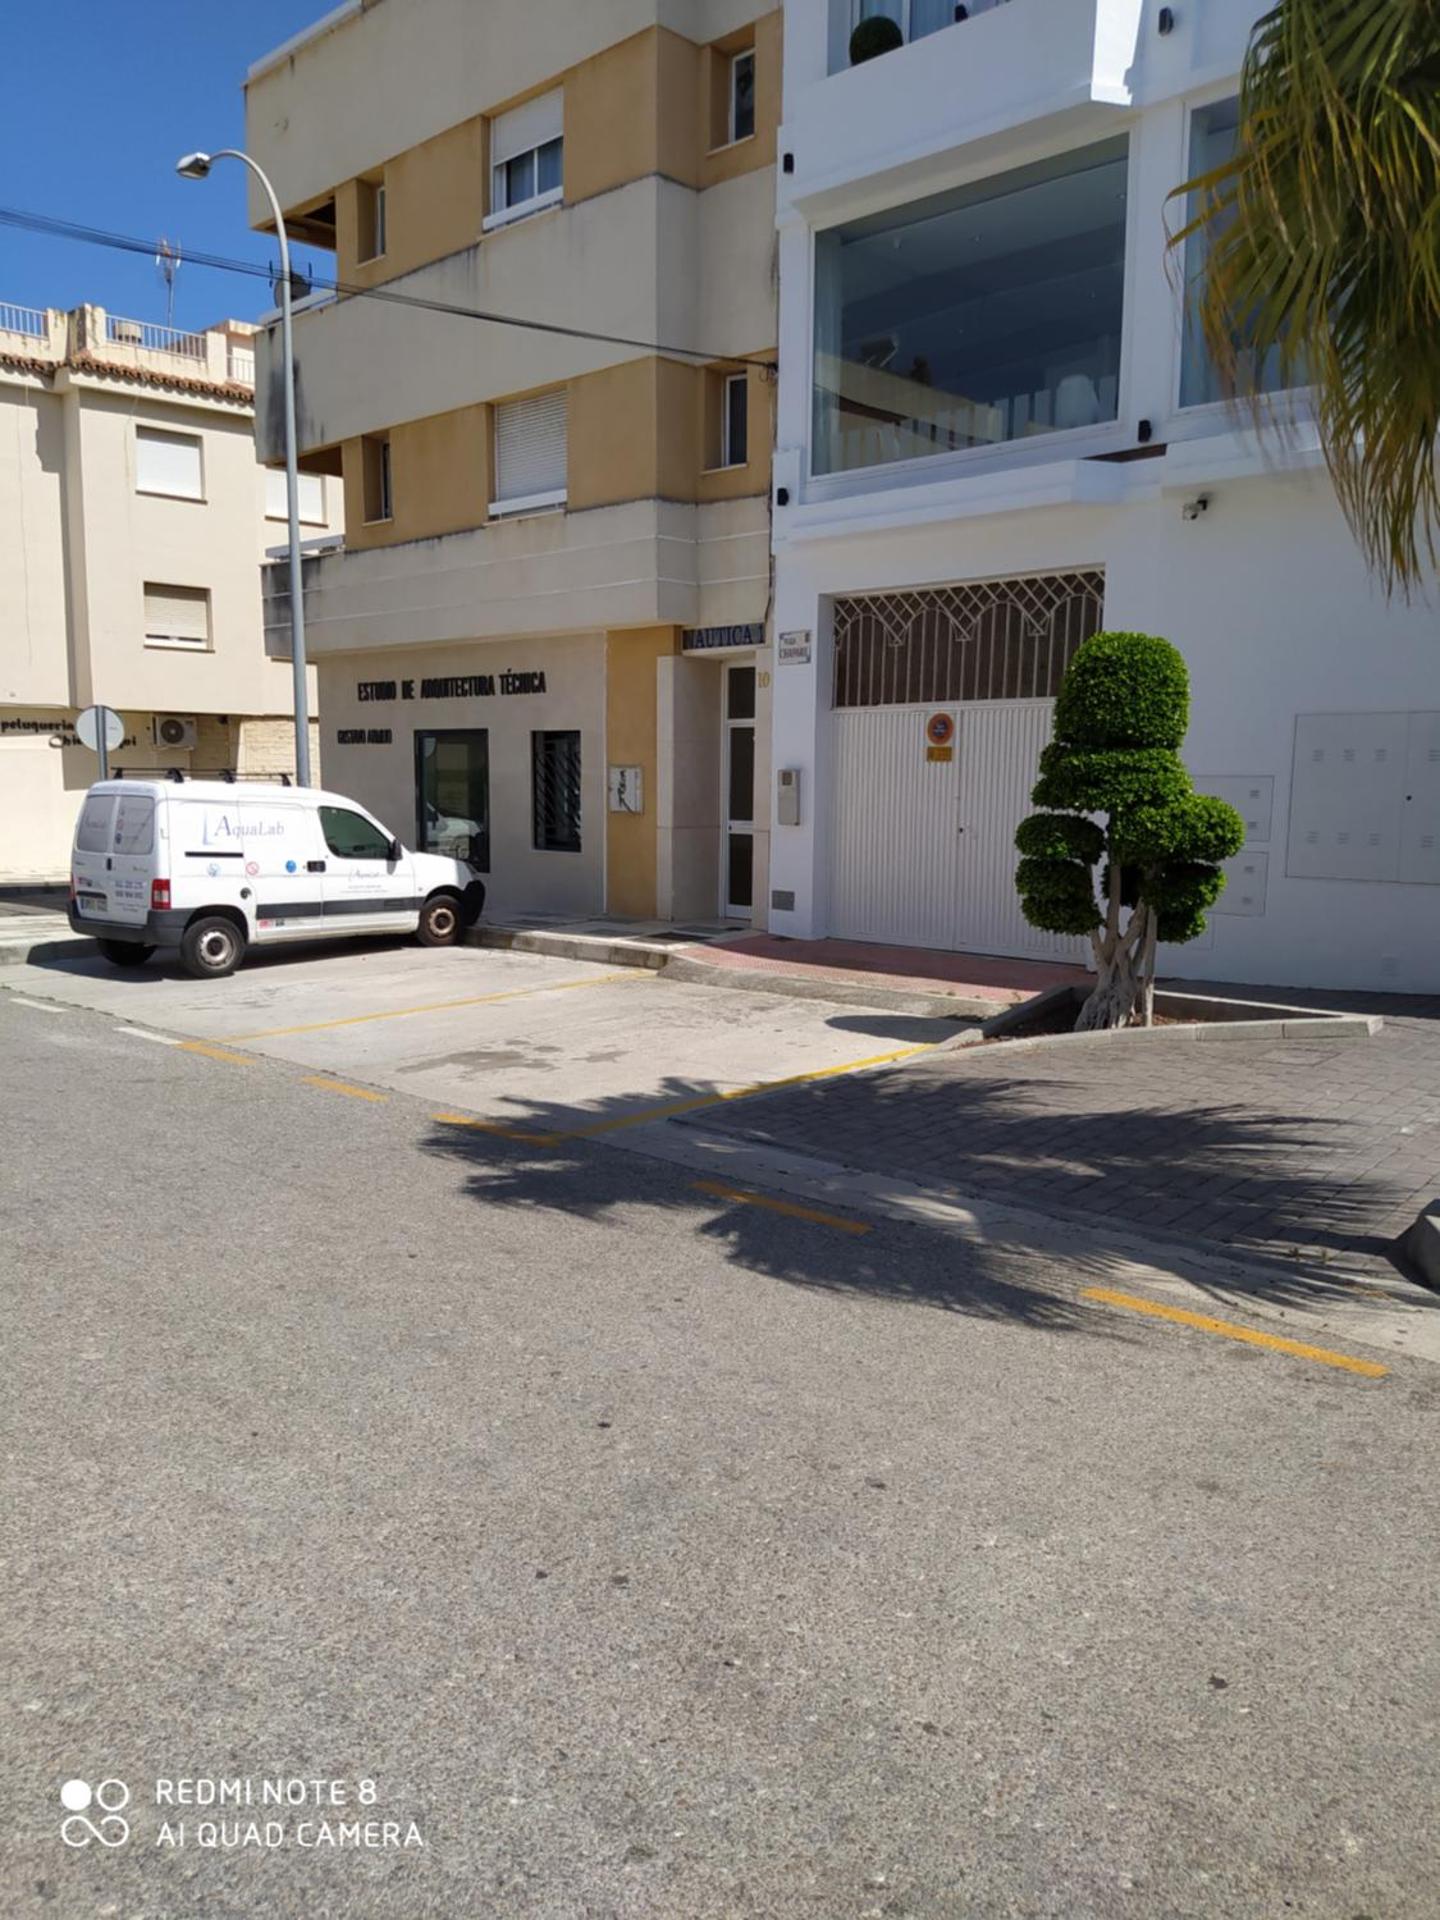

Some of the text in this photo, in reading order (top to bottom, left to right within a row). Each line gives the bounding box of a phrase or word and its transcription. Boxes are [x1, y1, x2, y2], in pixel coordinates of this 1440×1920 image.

[683, 626, 752, 649] NAUTICA
[358, 668, 546, 702] ESTUDIO DE ARQUITECTURA TÉCNICA
[758, 672, 770, 688] 10
[214, 815, 285, 840] AquaLab
